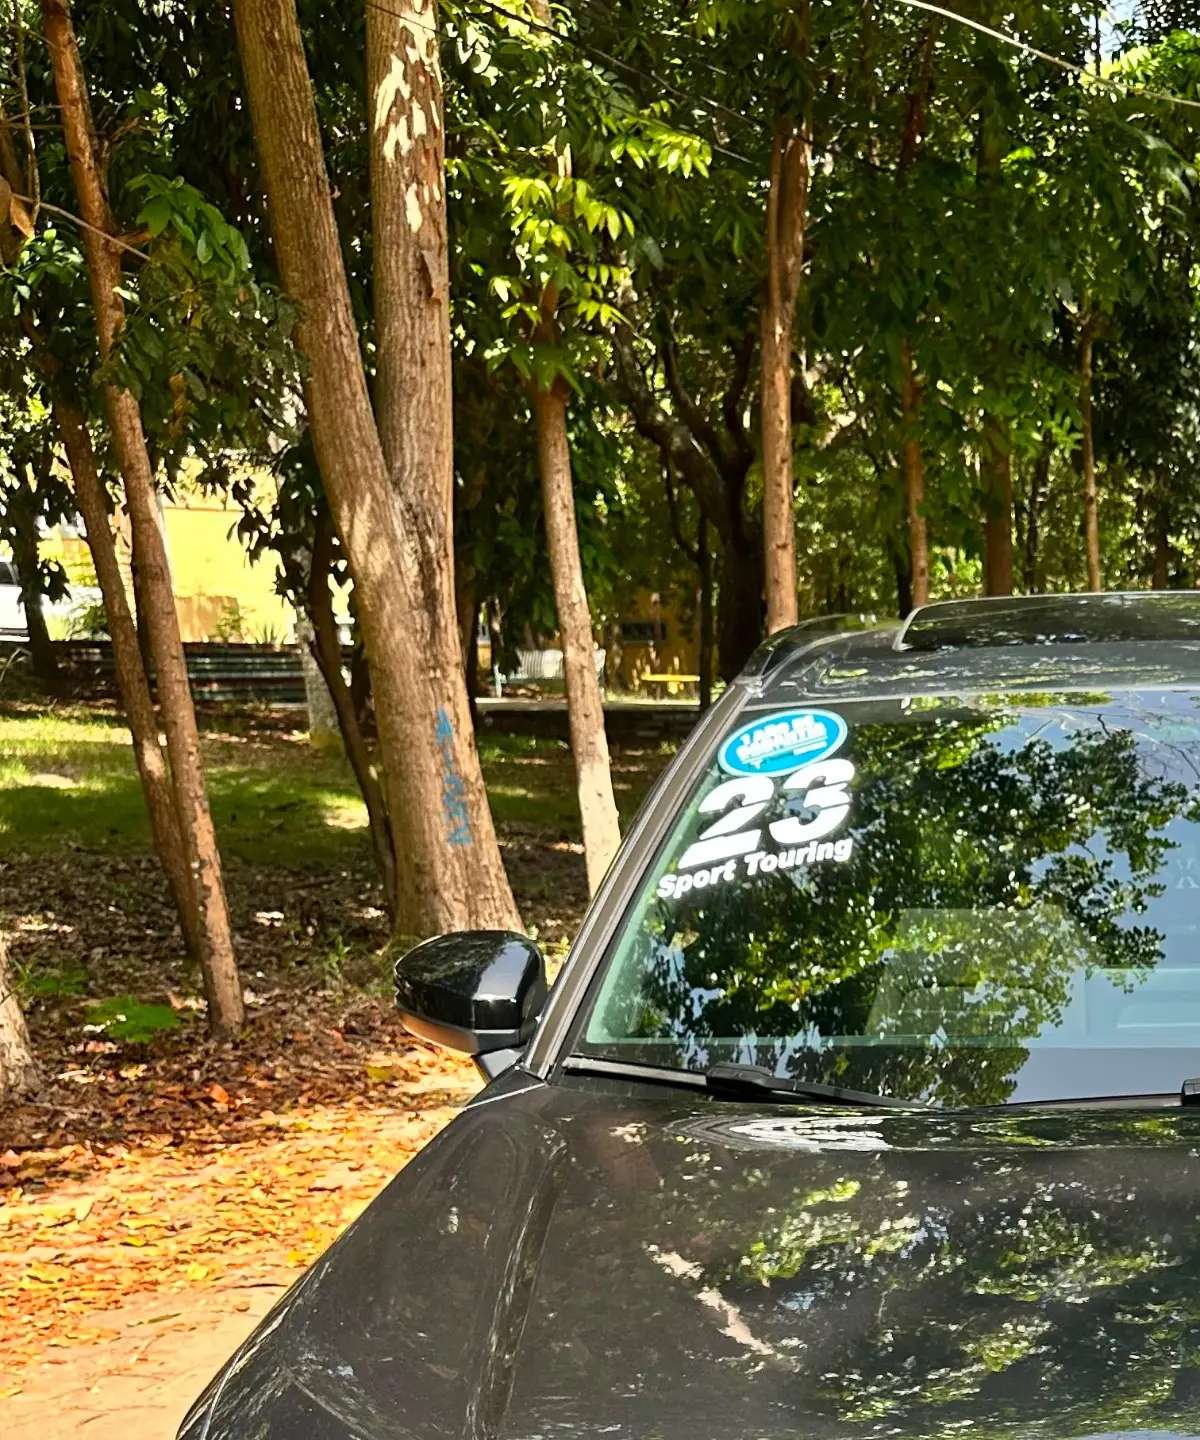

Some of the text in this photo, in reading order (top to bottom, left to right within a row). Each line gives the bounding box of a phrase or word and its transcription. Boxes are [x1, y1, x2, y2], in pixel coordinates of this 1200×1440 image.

[678, 758, 855, 869] 23
[657, 837, 853, 899] Sport Touring
